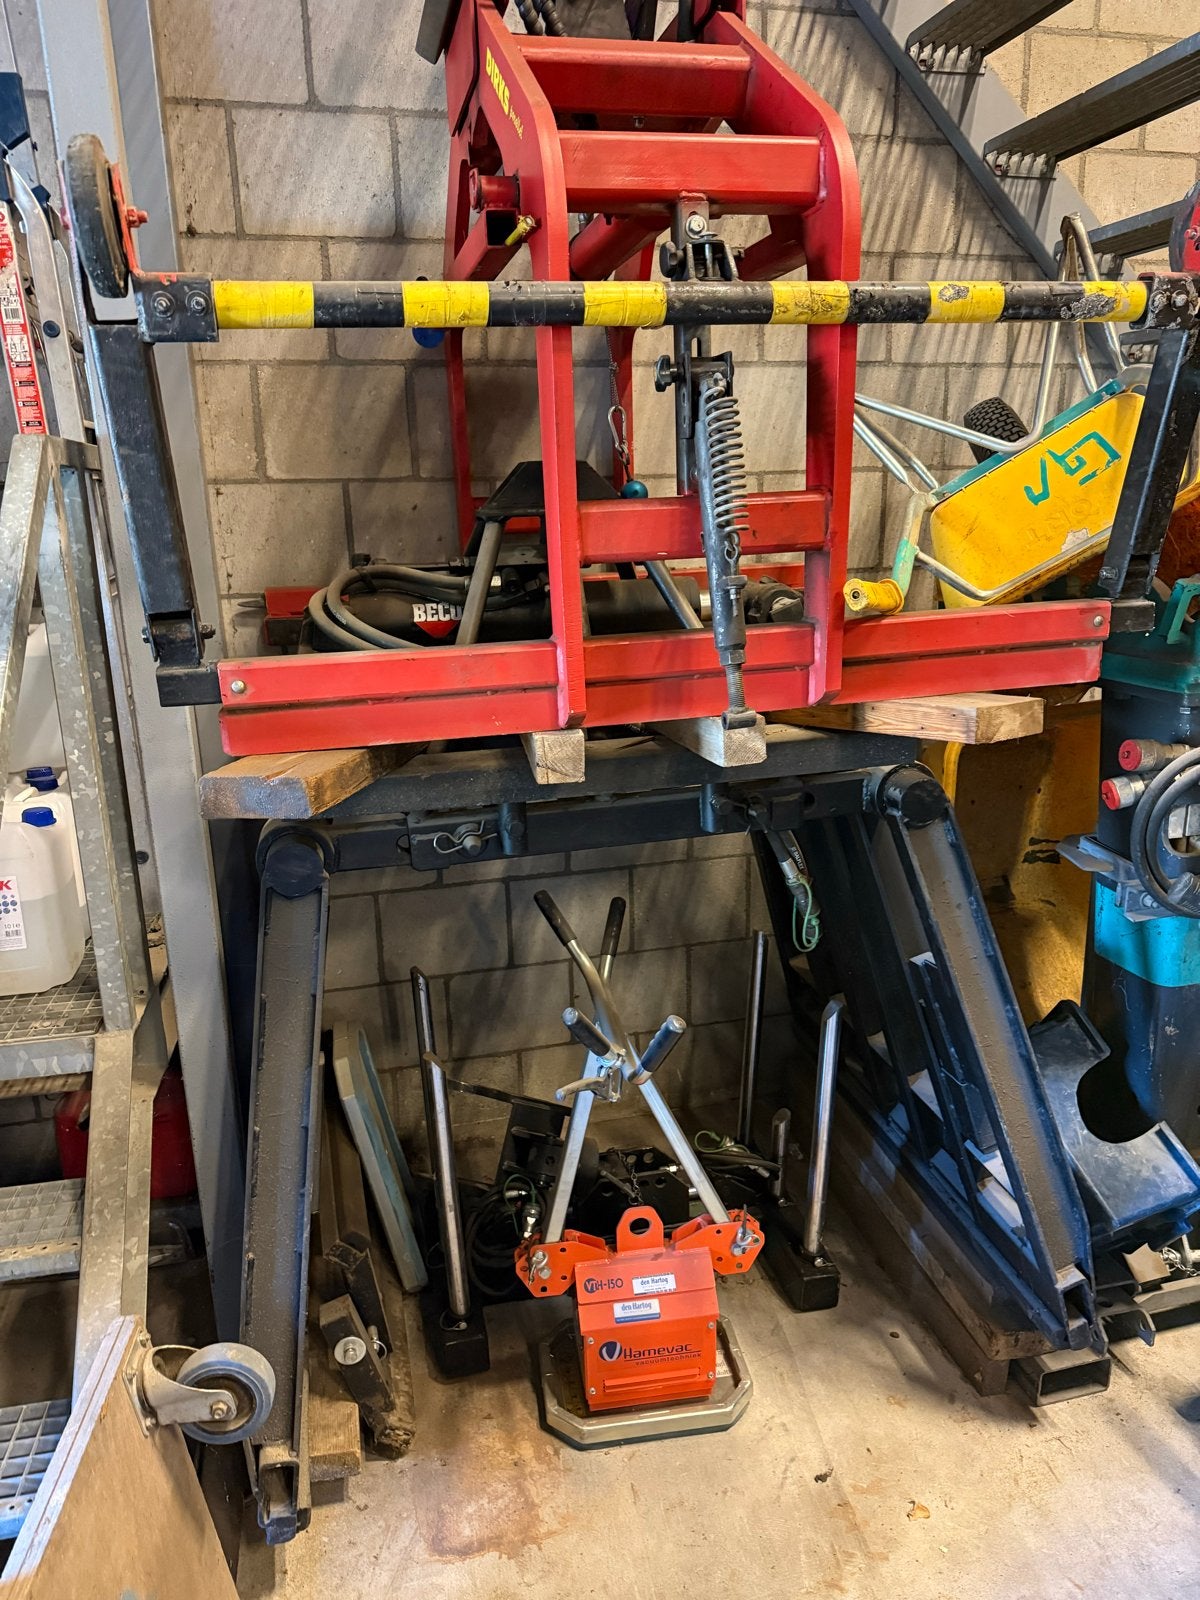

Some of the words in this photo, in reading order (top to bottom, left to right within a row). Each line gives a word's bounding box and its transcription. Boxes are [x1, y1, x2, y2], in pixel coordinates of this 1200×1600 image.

[486, 46, 510, 115] DIRKS
[651, 1277, 669, 1285] Hartog
[632, 1302, 652, 1311] Hartog
[624, 1343, 692, 1360] Hamevac
